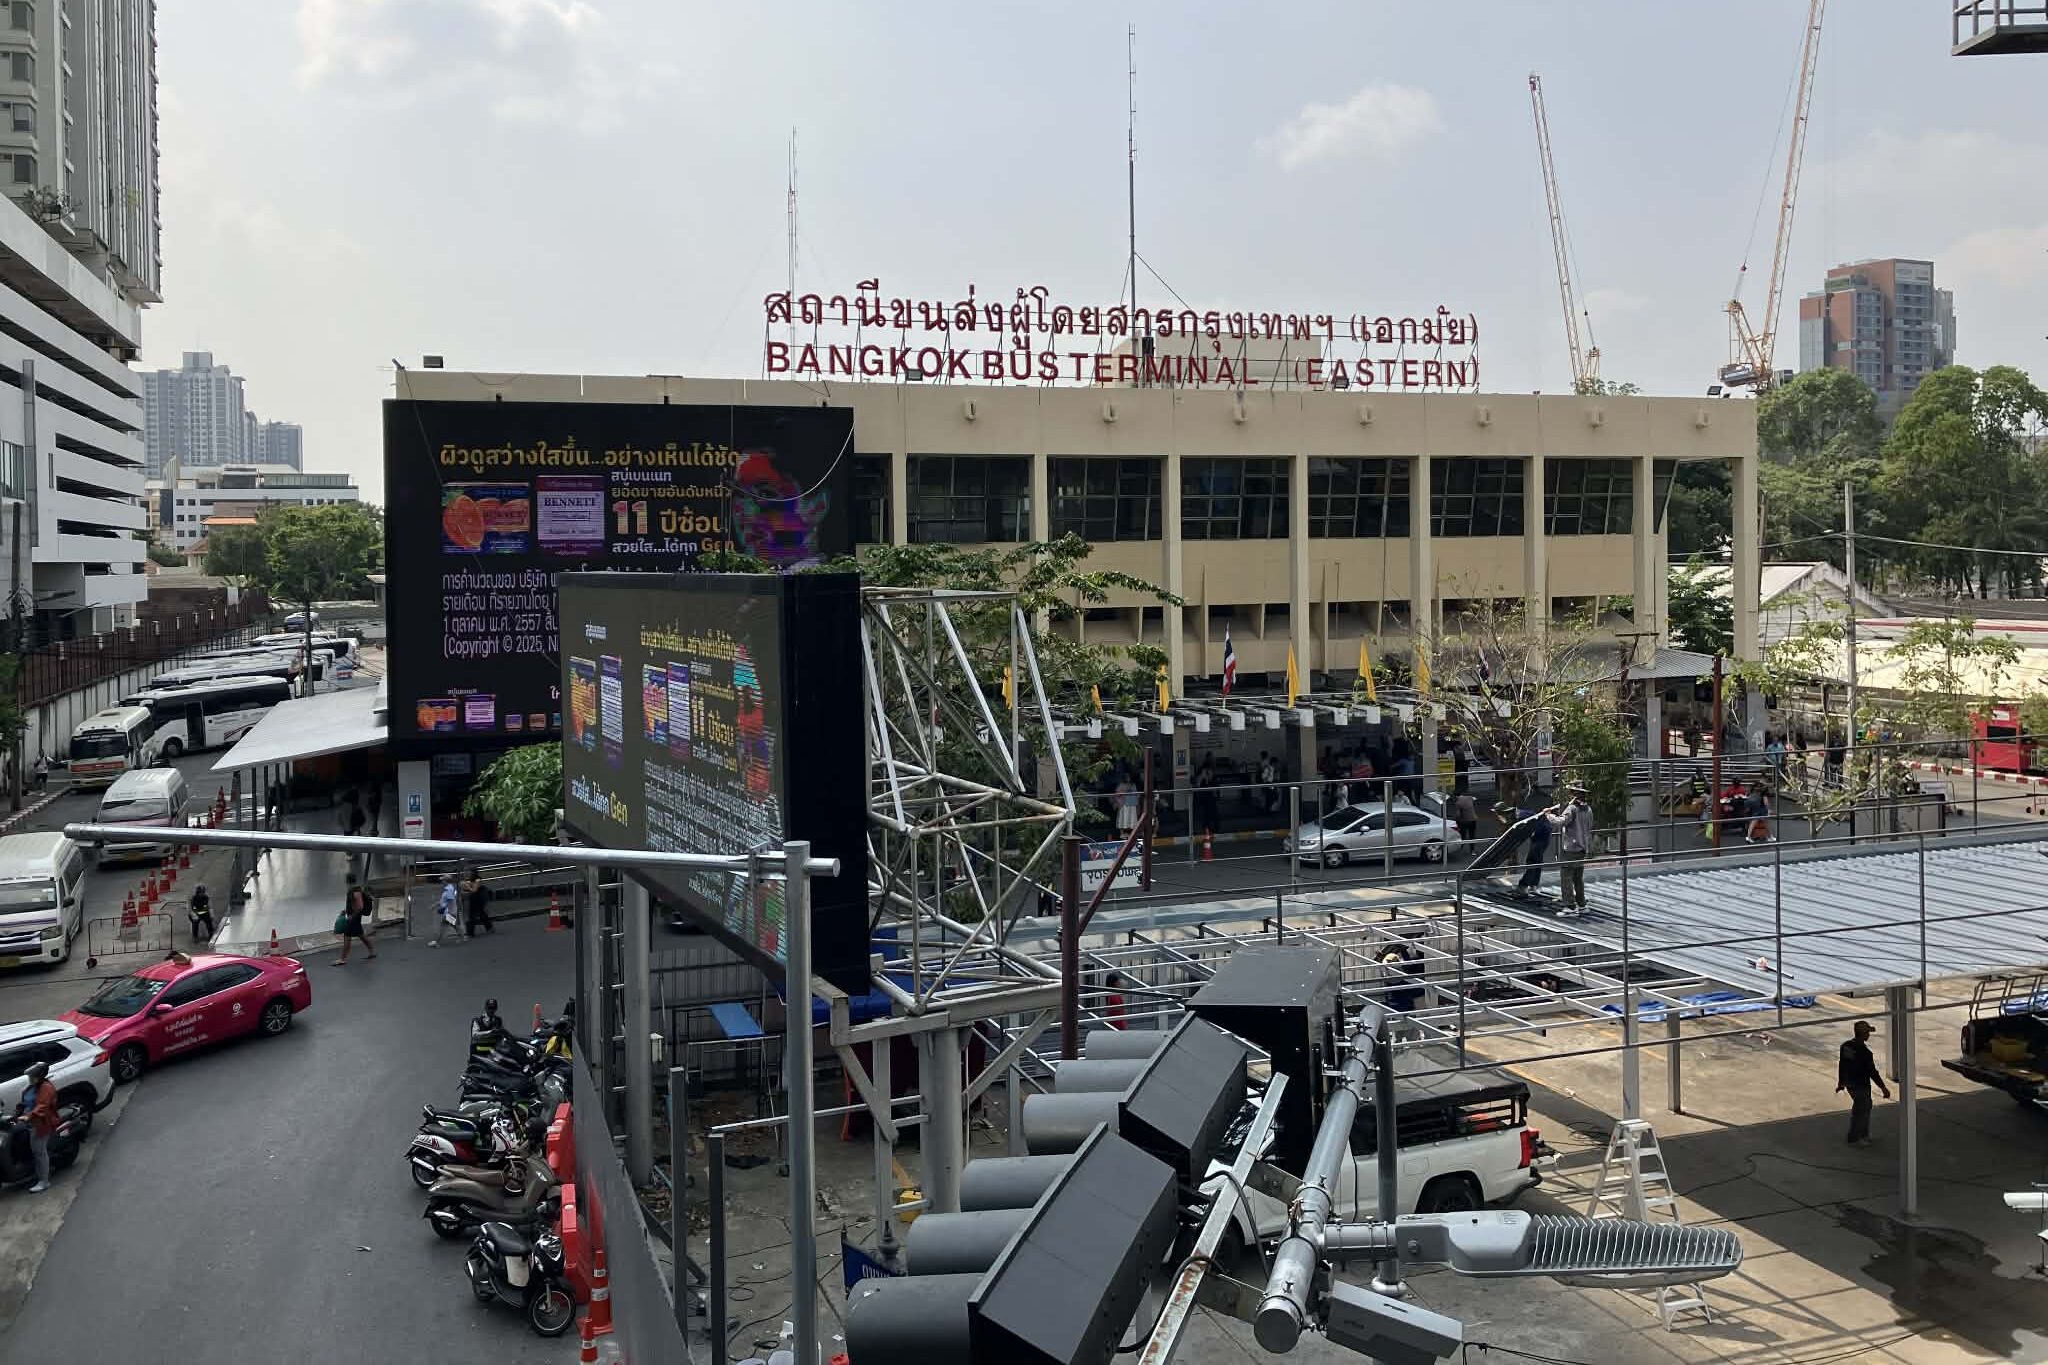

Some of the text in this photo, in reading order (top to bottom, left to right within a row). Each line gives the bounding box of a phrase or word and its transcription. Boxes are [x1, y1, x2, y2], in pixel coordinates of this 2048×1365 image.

[1350, 304, 1479, 345] (เอกมัย)
[767, 341, 1480, 388] BANGKOK BUS TERMINAL (EASTERN)
[612, 500, 648, 535] 11
[443, 617, 449, 632] 1
[443, 634, 499, 659] (Copyright
